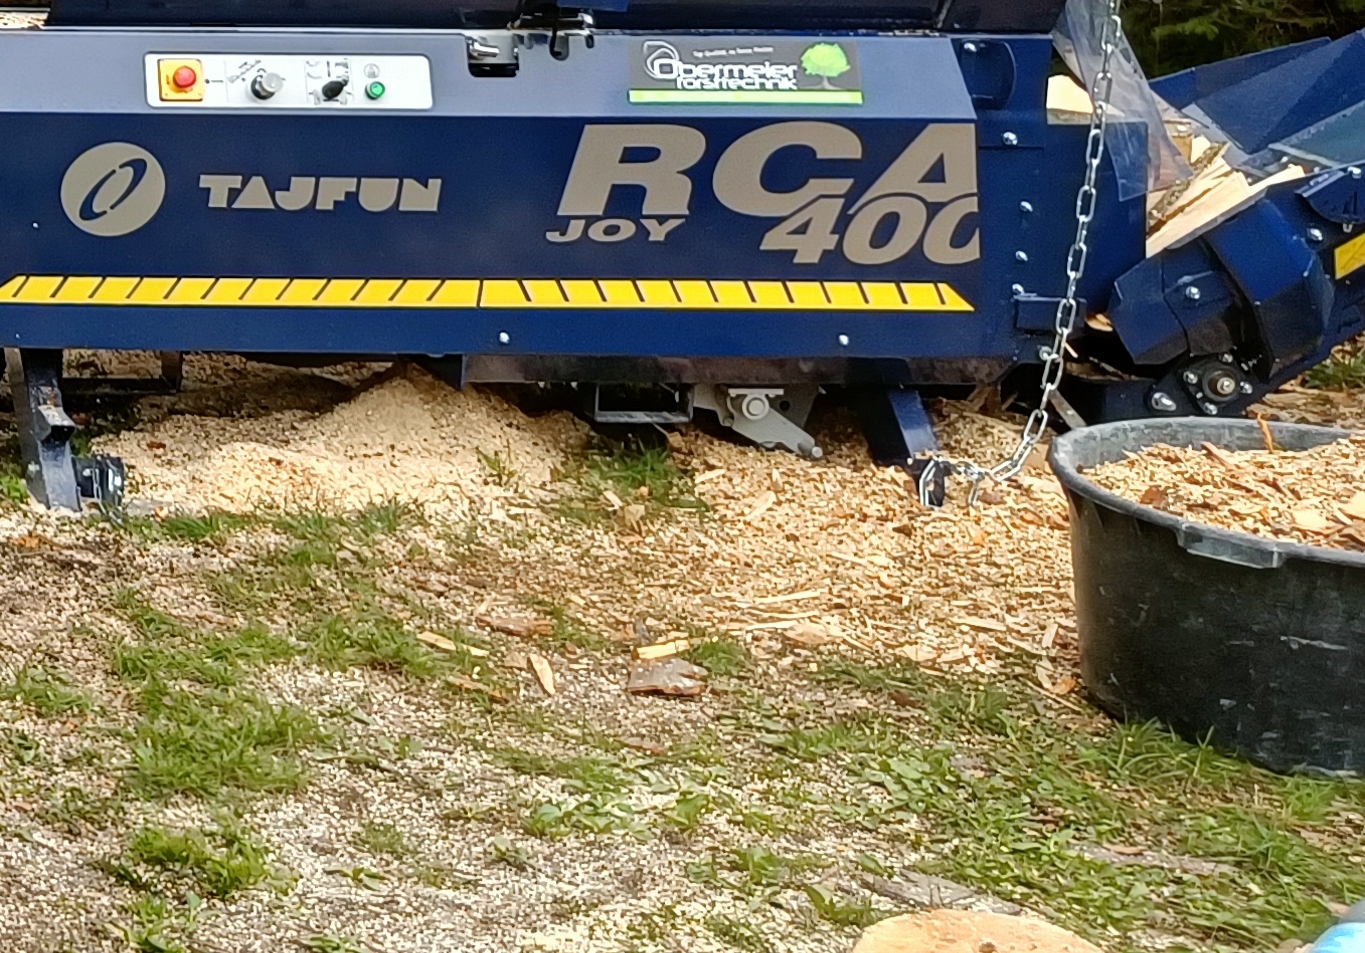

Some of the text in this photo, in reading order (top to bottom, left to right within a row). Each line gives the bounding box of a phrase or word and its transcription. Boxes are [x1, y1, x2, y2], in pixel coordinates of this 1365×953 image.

[199, 174, 442, 212] TAJFUN
[557, 121, 978, 217] RCA
[545, 218, 686, 243] JOY
[759, 195, 981, 265] 400
